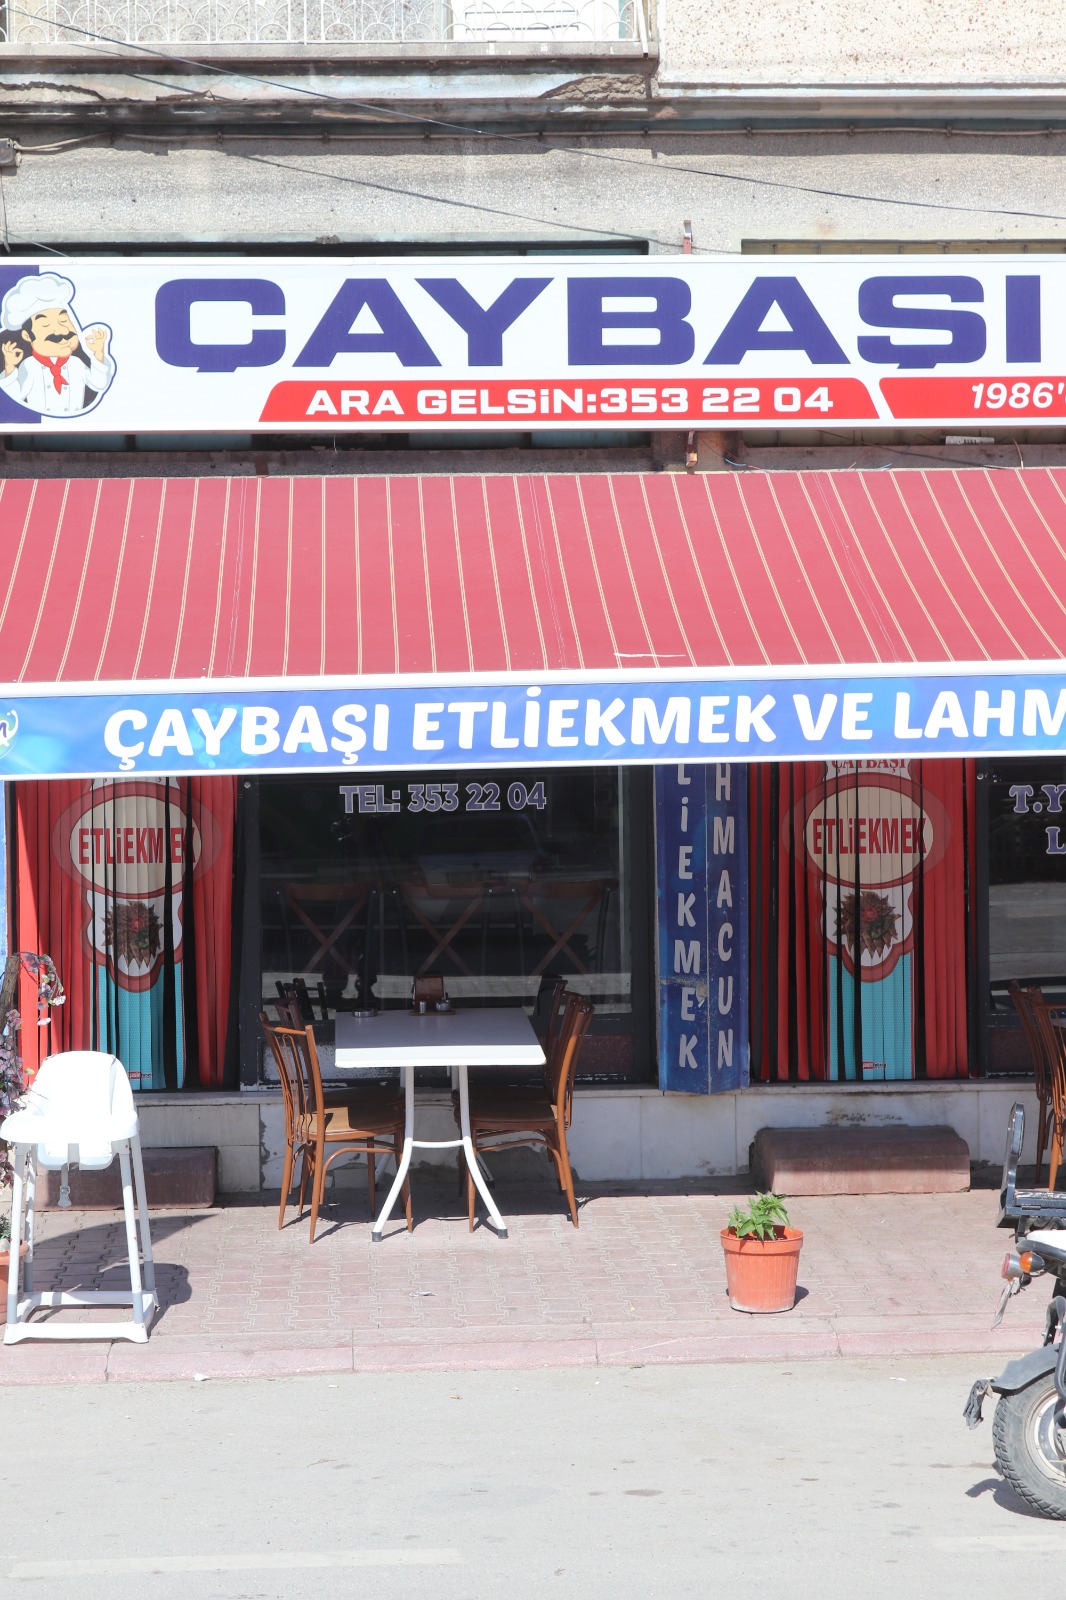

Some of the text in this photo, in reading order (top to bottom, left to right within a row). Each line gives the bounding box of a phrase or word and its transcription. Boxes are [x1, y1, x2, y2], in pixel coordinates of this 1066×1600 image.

[155, 275, 1042, 373] ÇAYBAŞI
[305, 389, 405, 416] ARA
[702, 387, 760, 413] 22
[773, 386, 834, 412] 04
[971, 381, 1066, 410] 1986'
[103, 703, 390, 771] ÇAYBAŞI
[411, 686, 777, 751] ETLİEKMEK
[792, 692, 875, 741] VE
[339, 781, 547, 813] TEL: 353 22 04
